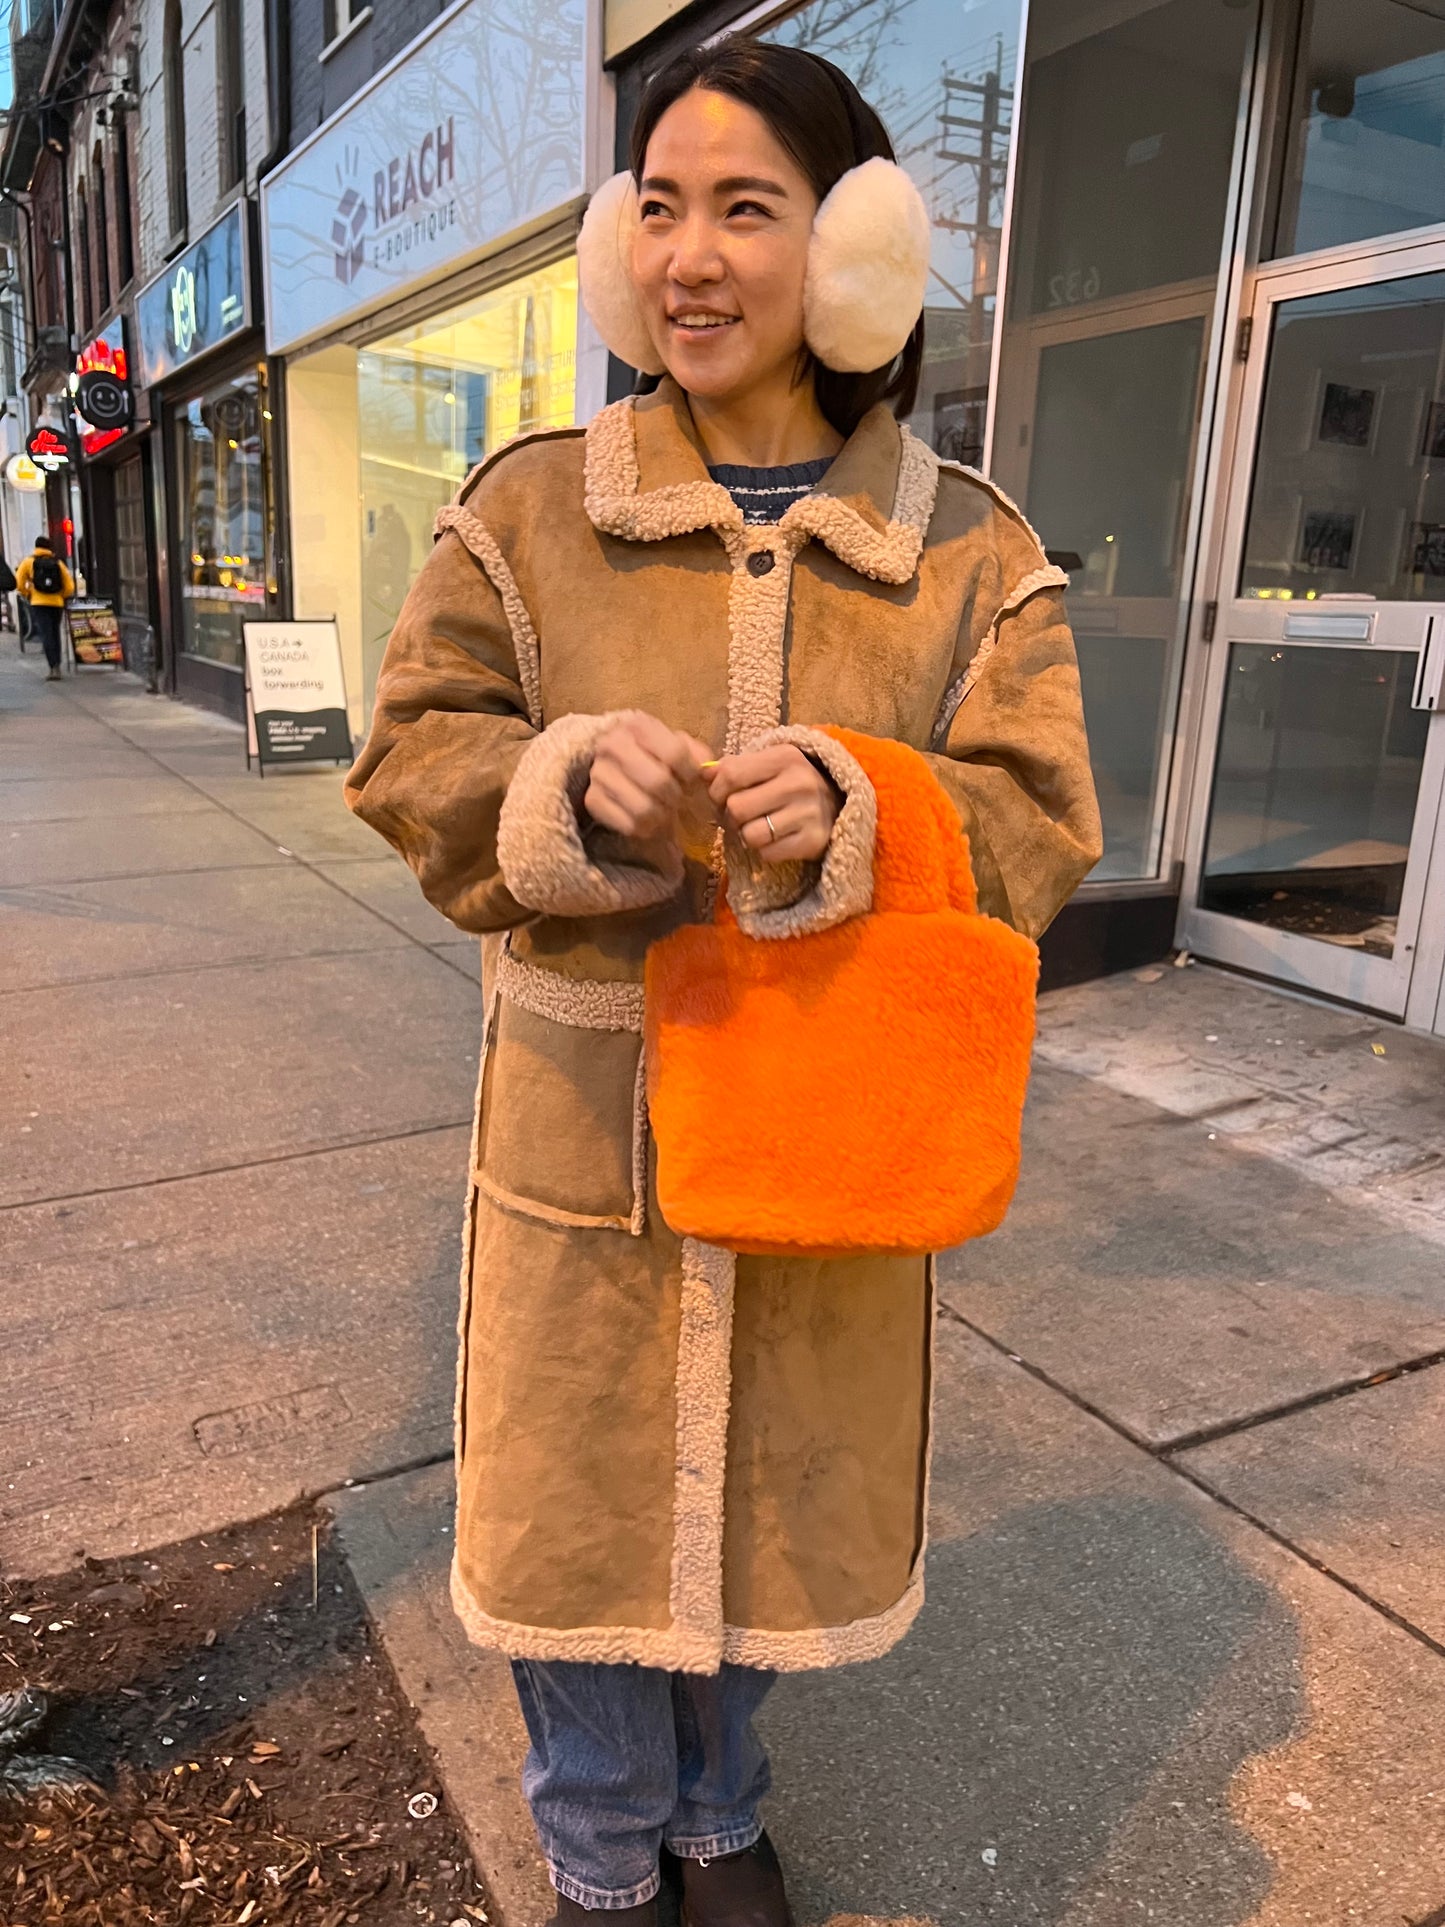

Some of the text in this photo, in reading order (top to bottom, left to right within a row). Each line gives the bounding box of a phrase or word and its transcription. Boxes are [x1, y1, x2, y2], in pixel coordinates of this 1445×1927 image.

[374, 115, 454, 229] REACH
[374, 199, 456, 269] E-BOUTIQUE
[257, 637, 290, 649] USA
[260, 651, 309, 662] CANADA
[263, 666, 282, 676] box
